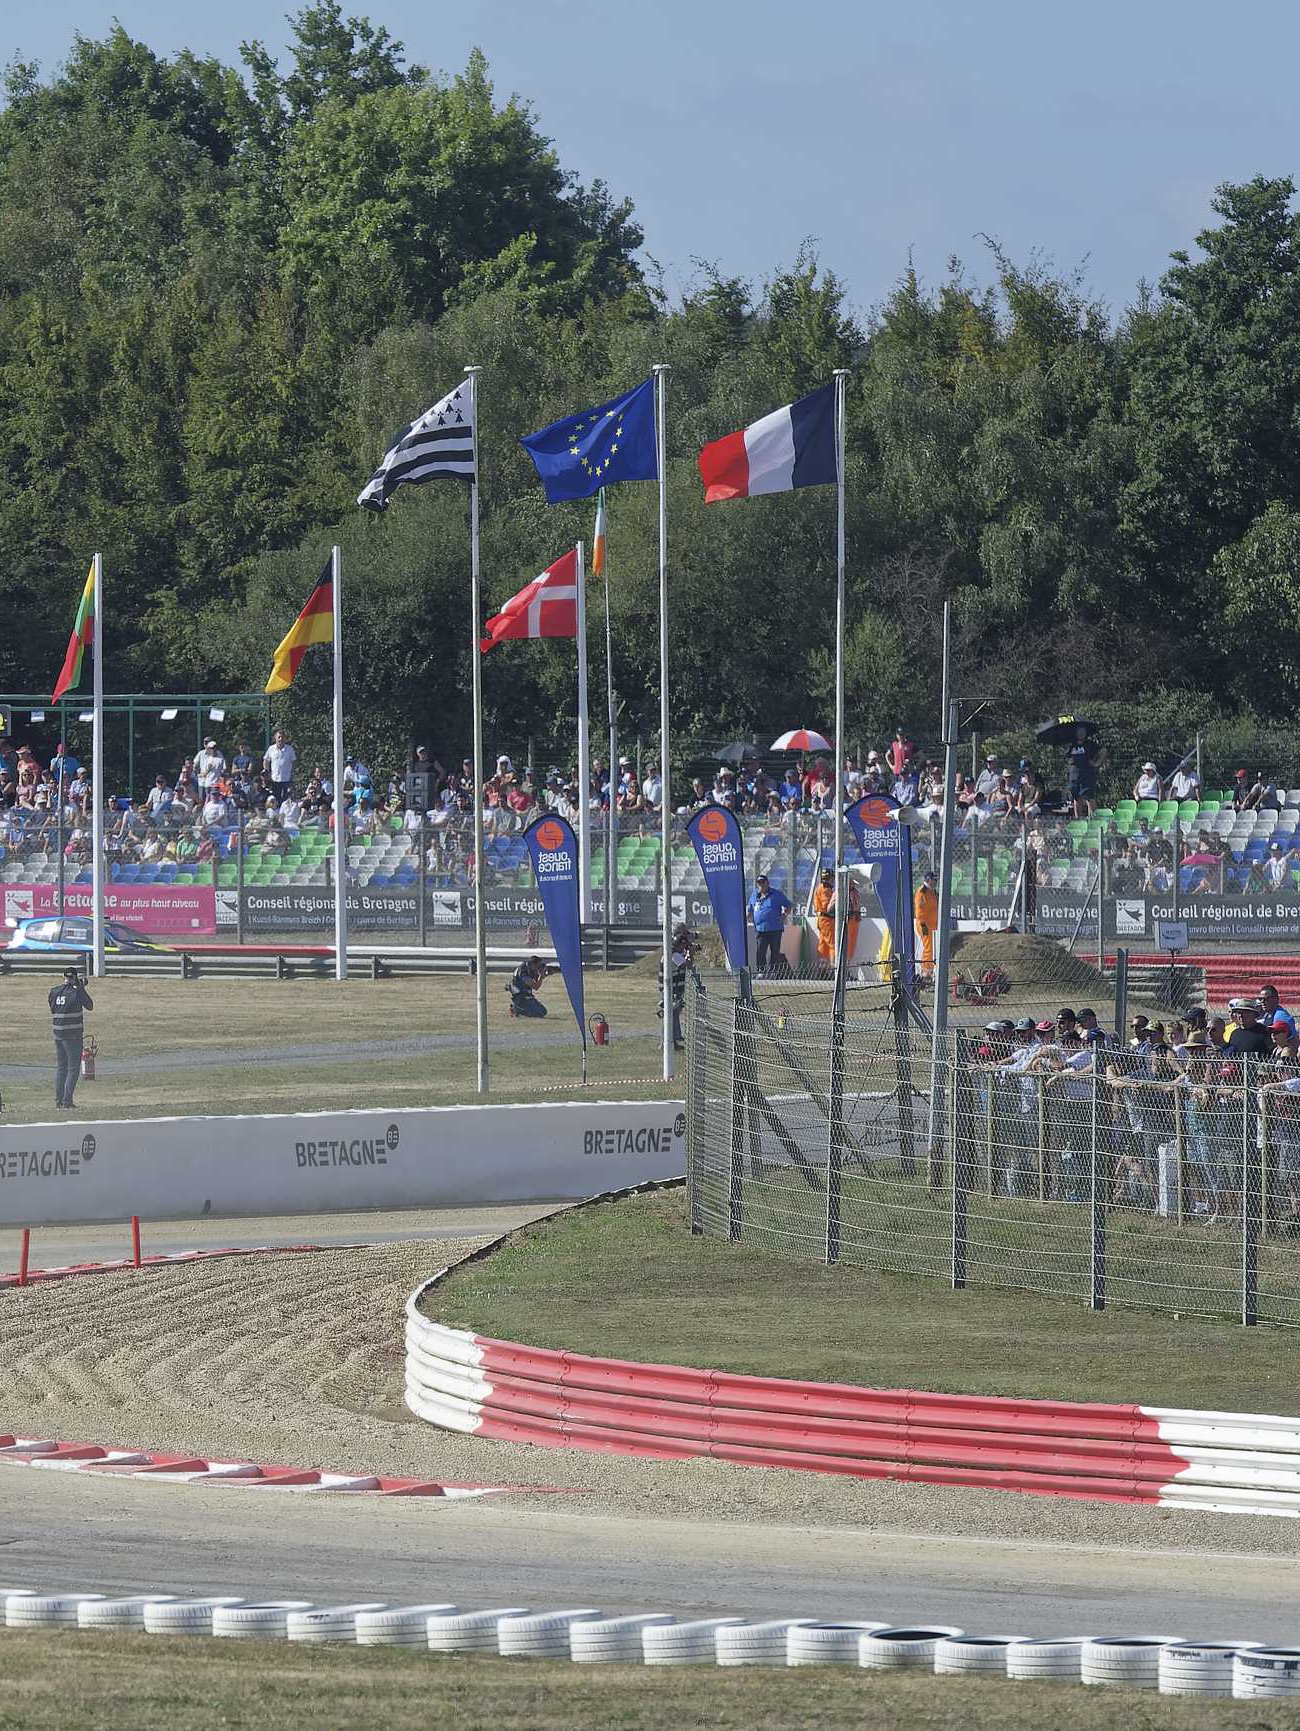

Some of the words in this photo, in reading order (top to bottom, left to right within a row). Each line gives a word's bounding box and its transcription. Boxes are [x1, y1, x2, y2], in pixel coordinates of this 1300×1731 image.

[40, 896, 50, 907] La
[132, 898, 150, 909] plus
[151, 898, 170, 908] haut
[172, 898, 199, 908] niveau
[247, 896, 291, 909] Conseil
[294, 896, 337, 912] régiona
[346, 895, 359, 909] de
[362, 896, 416, 912] Bretagne
[467, 897, 512, 910] Cnseil
[515, 897, 545, 913] régio
[1041, 905, 1098, 921] Bretagne
[1202, 904, 1253, 921] régional
[1257, 904, 1273, 918] de
[1276, 904, 1300, 918] Bre
[56, 996, 66, 1005] 65
[584, 1127, 672, 1154] BRETAGNE
[295, 1139, 387, 1167] BRETAGNE
